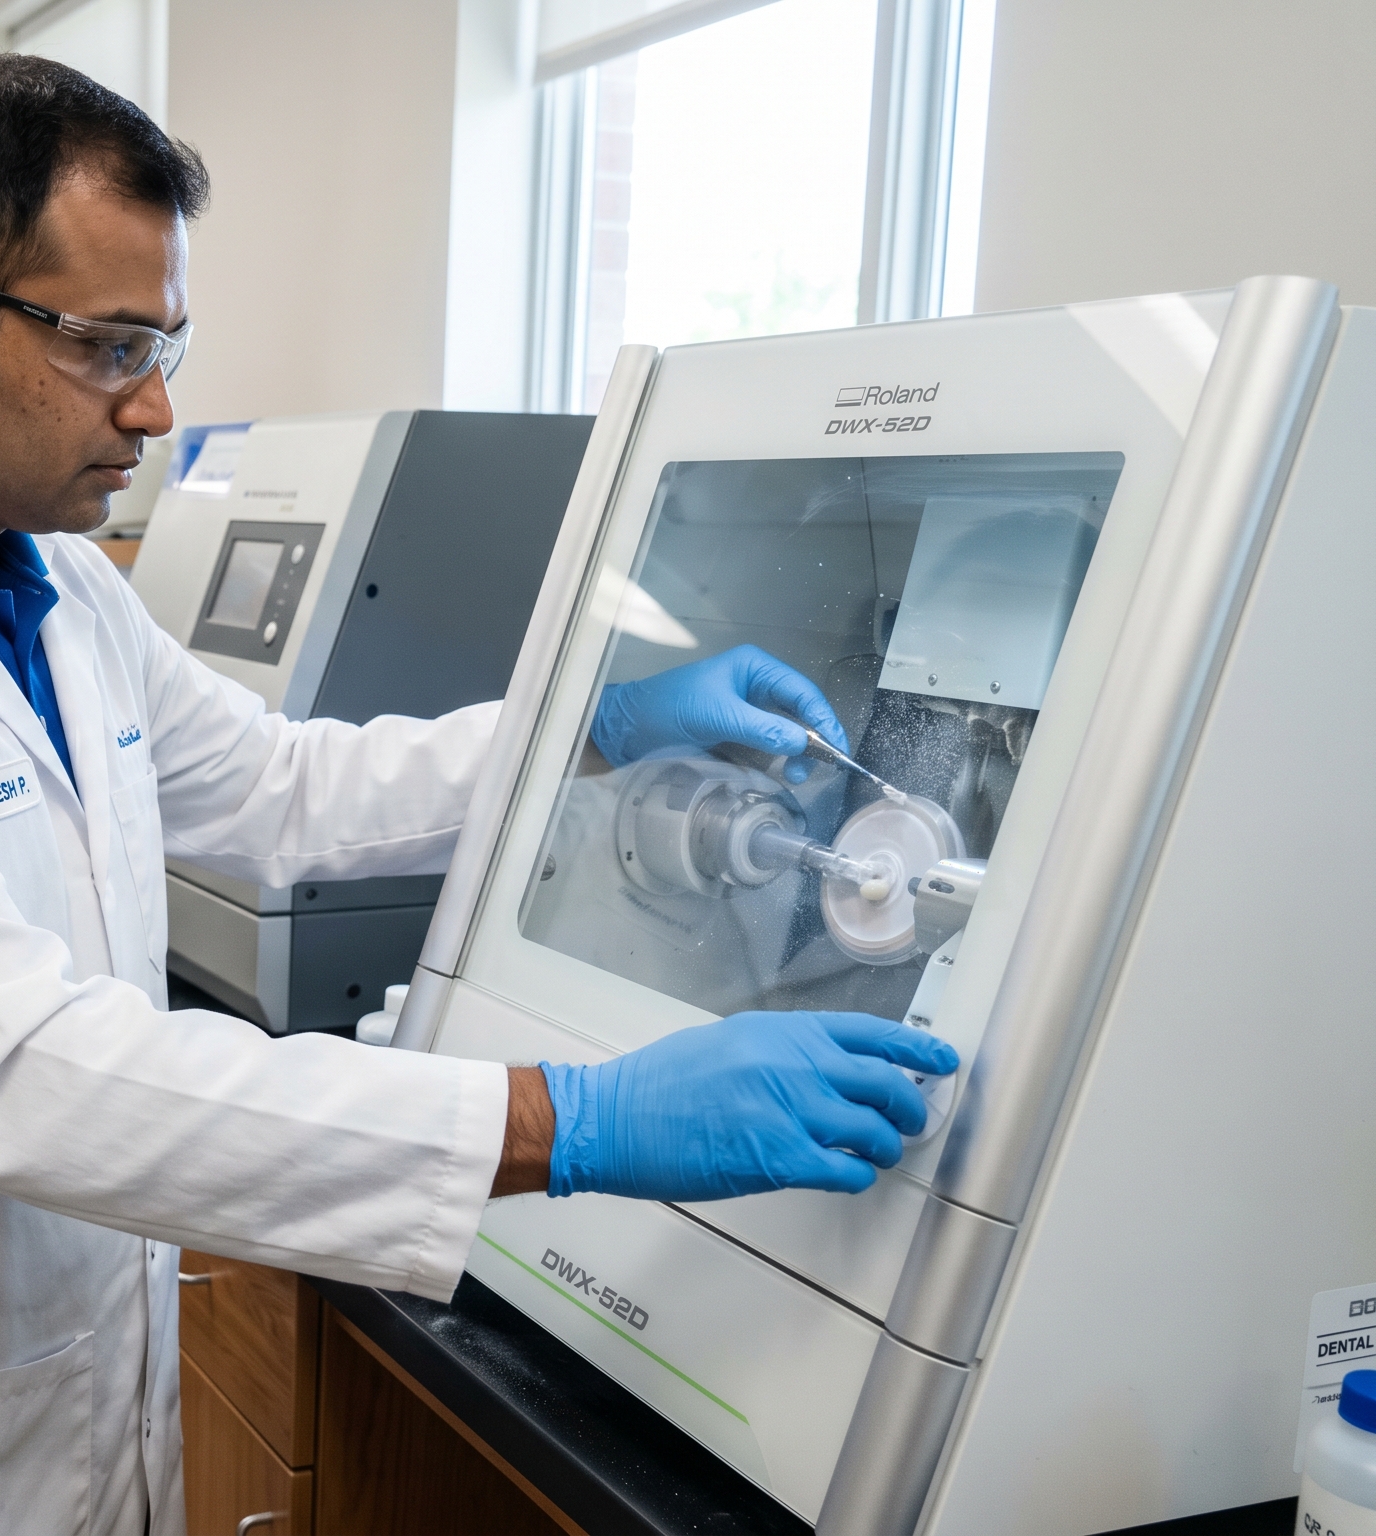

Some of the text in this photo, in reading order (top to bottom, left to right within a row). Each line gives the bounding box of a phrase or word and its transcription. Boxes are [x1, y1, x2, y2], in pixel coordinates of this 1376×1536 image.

[863, 382, 940, 406] Roland
[824, 416, 932, 435] DWX-52D
[17, 775, 30, 795] P.
[540, 1247, 650, 1331] DWX-52D
[1317, 1335, 1374, 1358] DENTAL
